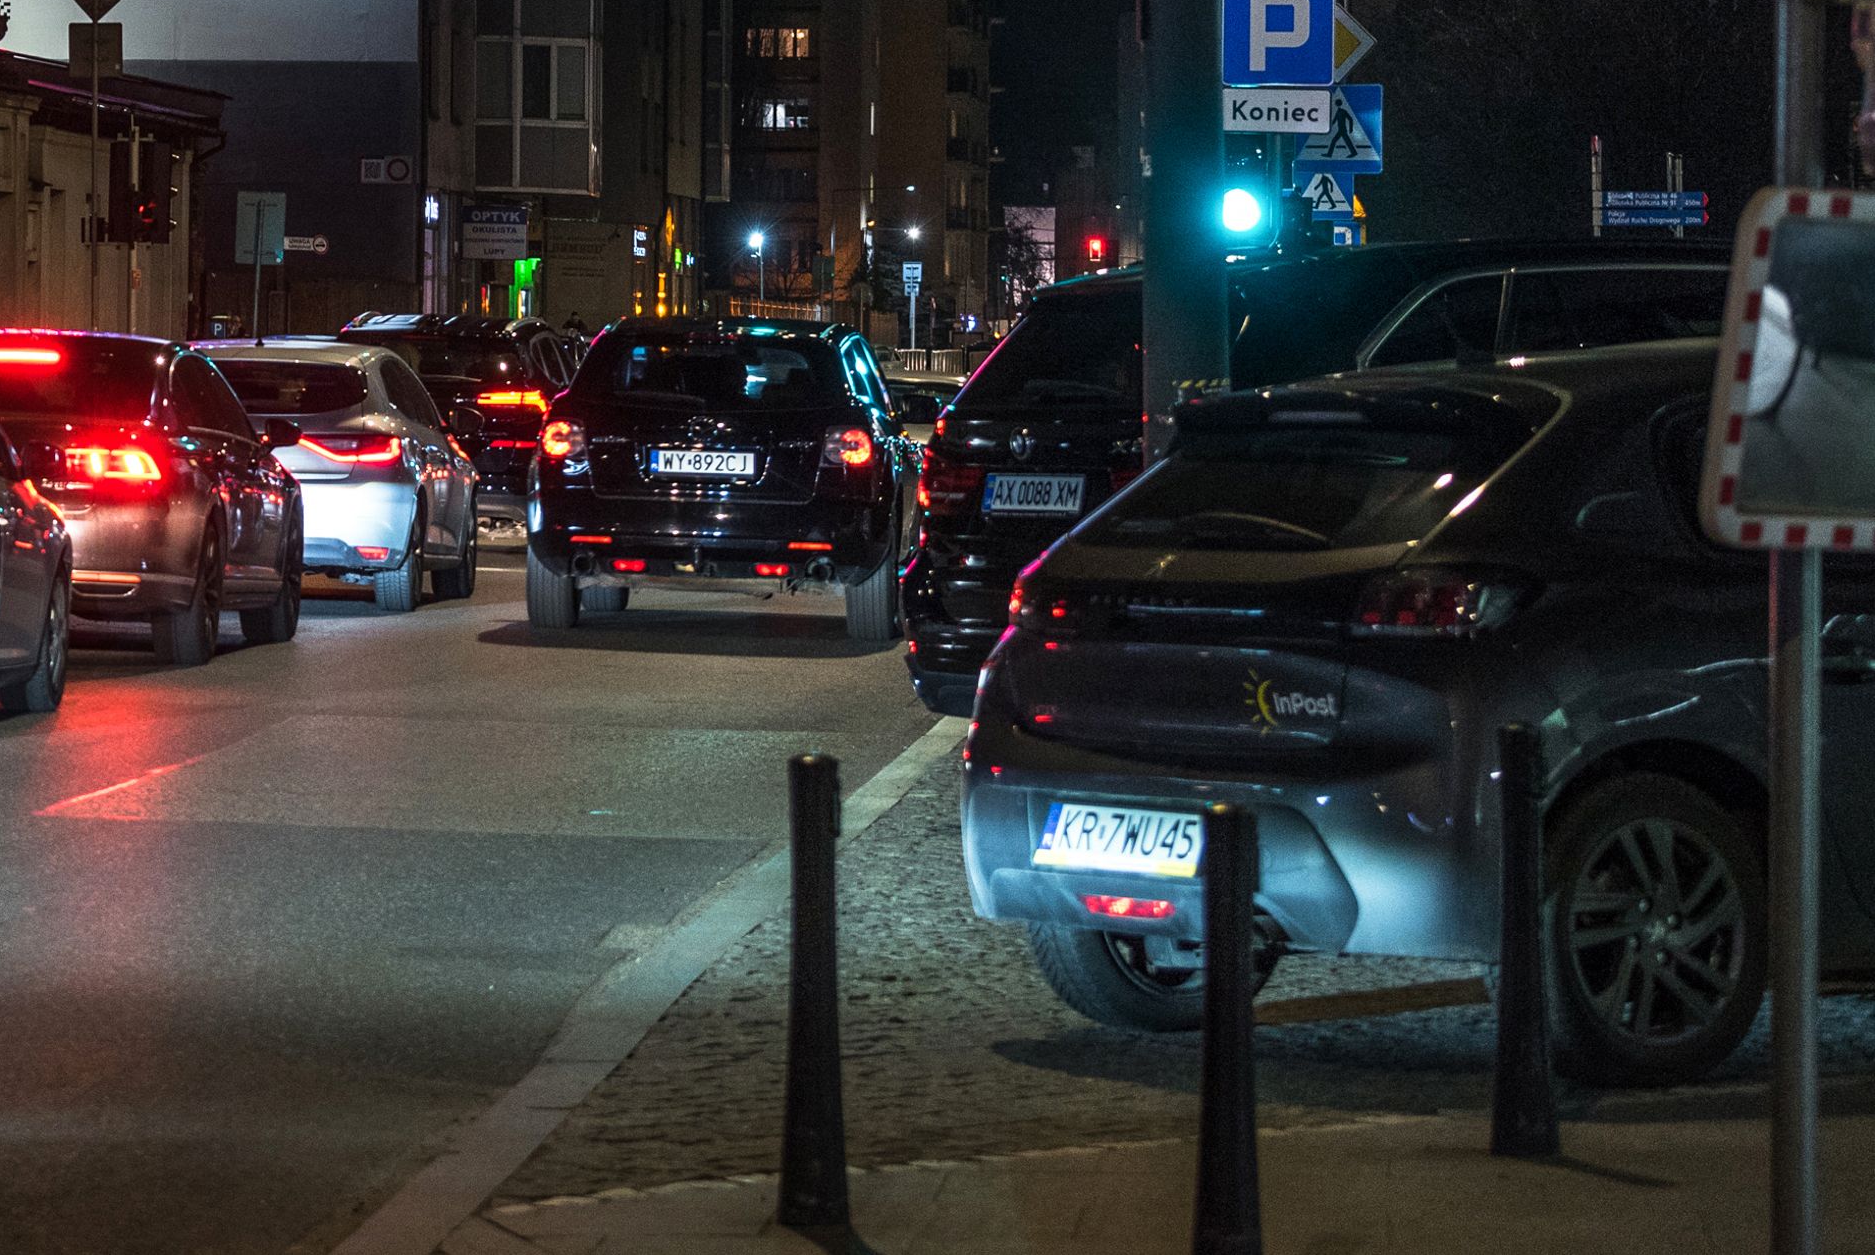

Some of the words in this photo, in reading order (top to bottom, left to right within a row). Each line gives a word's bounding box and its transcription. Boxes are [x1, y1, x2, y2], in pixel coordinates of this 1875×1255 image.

[1232, 100, 1319, 122] Koniec
[471, 210, 521, 223] OPTYK
[472, 226, 518, 234] OKULISTA
[662, 453, 686, 471] WY
[694, 454, 747, 472] 892CJ
[993, 480, 1017, 507] AX
[1017, 480, 1053, 506] 0088
[1054, 482, 1079, 508] XM
[1273, 693, 1338, 716] InPost
[1059, 810, 1100, 851] KR
[1103, 813, 1199, 859] 7WU45
